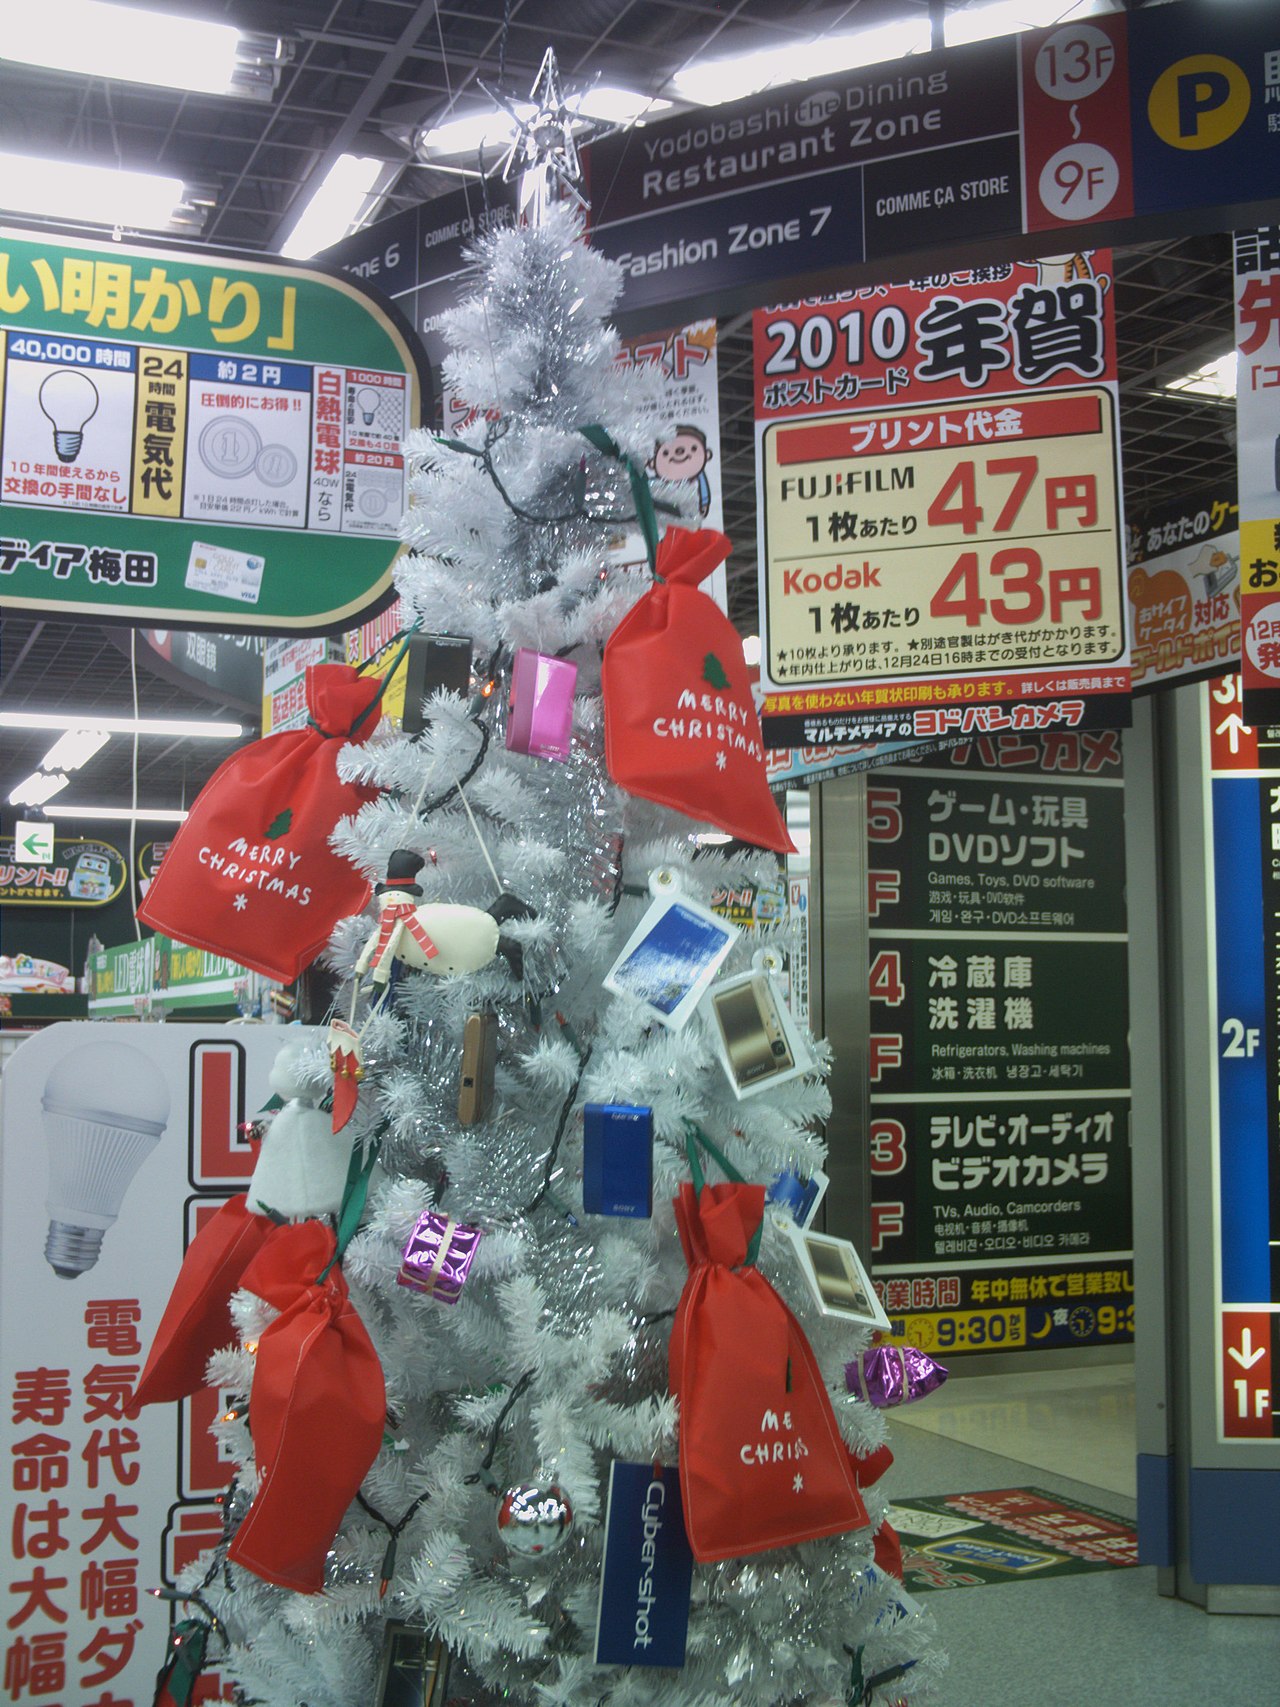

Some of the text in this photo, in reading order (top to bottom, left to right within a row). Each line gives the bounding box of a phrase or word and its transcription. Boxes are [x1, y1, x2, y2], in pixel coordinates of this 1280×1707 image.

[1043, 39, 1112, 87] 13F
[644, 103, 789, 163] Yodobashi
[845, 70, 948, 112] Dining
[1177, 71, 1231, 138] P
[642, 109, 941, 198] Restaurant Zone
[876, 191, 931, 217] COMME
[960, 176, 1009, 202] STORE
[1053, 160, 1104, 205] 9F
[425, 222, 460, 248] COMME
[727, 219, 800, 255] Zone
[809, 206, 832, 236] 7
[385, 243, 400, 267] 6
[764, 283, 1105, 388] 2010 年賀
[143, 357, 184, 380] 24
[763, 368, 911, 411] ポストカード
[314, 370, 342, 475] 白熱電球
[849, 408, 1023, 452] プリント代金
[141, 400, 177, 500] 電気代
[4, 477, 127, 504] 交換の手間なし
[806, 511, 918, 543] 1枚あたり
[783, 562, 882, 596] Kodak
[808, 603, 920, 635] 1枚あたり
[1194, 593, 1230, 627] 対応
[677, 688, 748, 726] MERRY
[913, 701, 1085, 736] ヨドバシカメラ
[653, 717, 762, 763] CHRISTMAS
[928, 789, 1089, 829] ゲーム・玩具
[228, 837, 302, 870] MERRY
[928, 832, 1085, 868] DVDソフト
[198, 847, 312, 905] CHRISTMAS
[928, 872, 1095, 889] Games, Toys, DVD software
[928, 955, 1033, 989] 冷蔵庫
[928, 997, 1034, 1030] 洗濯機
[931, 1043, 1111, 1058] Refrigerators, Washing machines
[1222, 1018, 1260, 1058] 2F
[930, 1111, 1114, 1149] テレビ・オーディオ
[932, 1153, 1108, 1190] ビデオカメラ
[963, 1204, 1003, 1217] Audio,
[1006, 1200, 1081, 1215] Camcorders
[937, 1314, 1005, 1347] 9:30
[1234, 1379, 1270, 1418] 1F
[79, 1298, 144, 1707] 電気代大幅ダ
[633, 1480, 665, 1651] Cyber-shot
